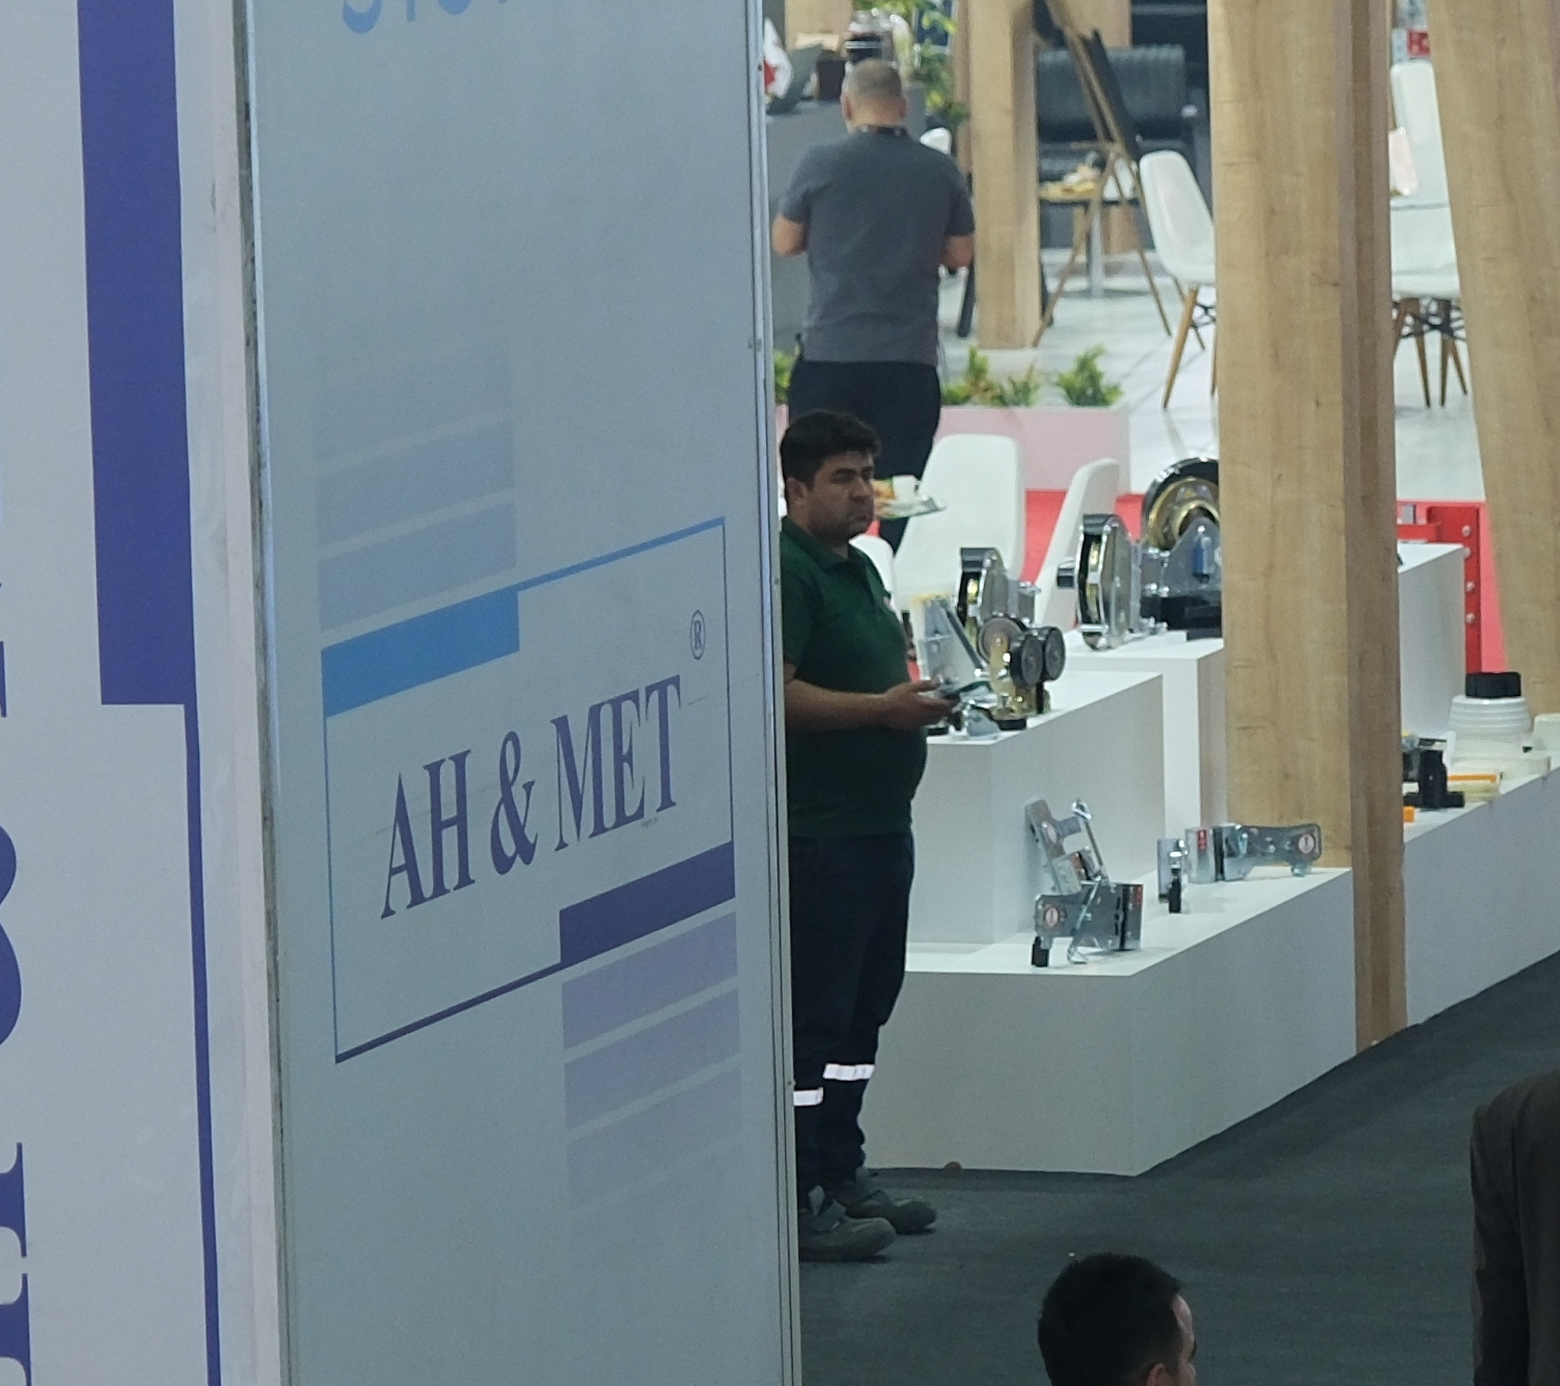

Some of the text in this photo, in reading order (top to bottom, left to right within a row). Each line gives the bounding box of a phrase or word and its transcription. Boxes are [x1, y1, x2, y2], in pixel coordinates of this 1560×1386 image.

[380, 749, 475, 919] AH
[490, 731, 538, 875] &
[550, 675, 680, 852] MET
